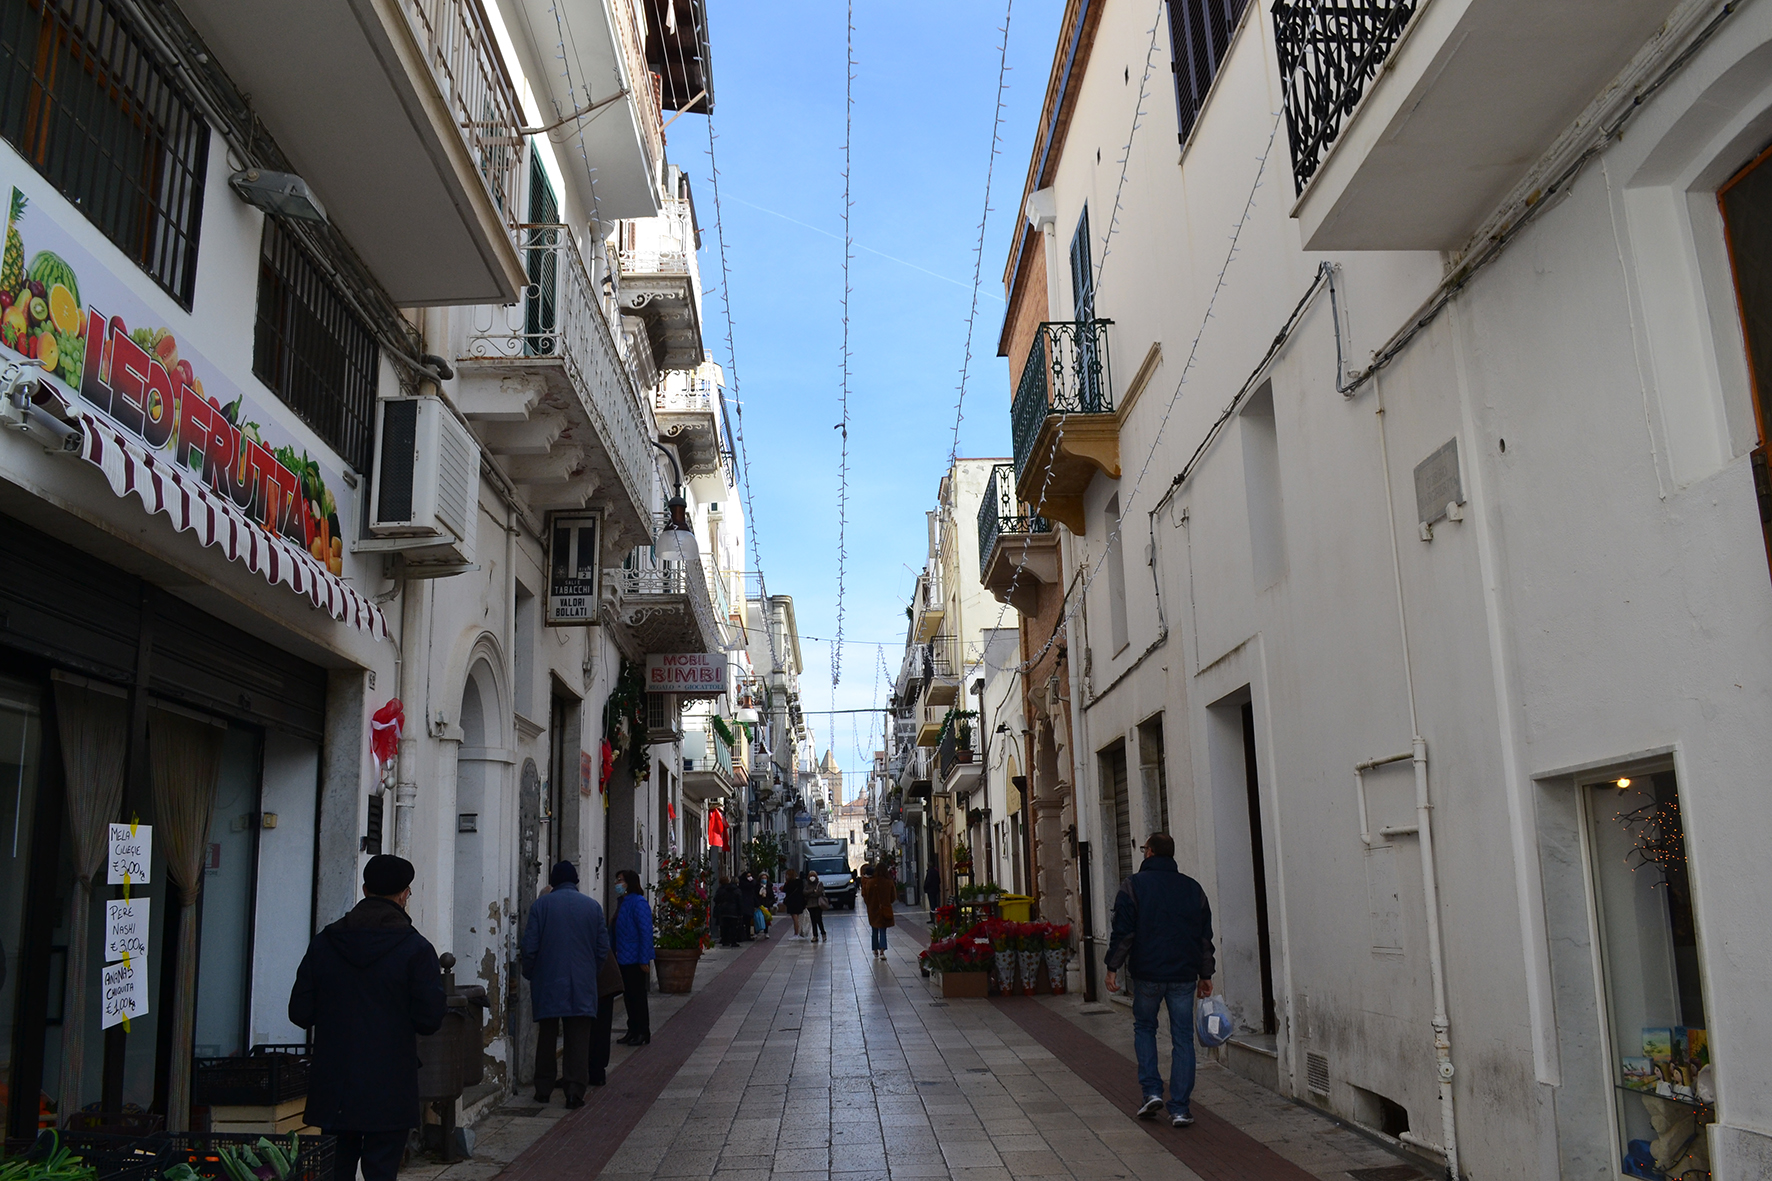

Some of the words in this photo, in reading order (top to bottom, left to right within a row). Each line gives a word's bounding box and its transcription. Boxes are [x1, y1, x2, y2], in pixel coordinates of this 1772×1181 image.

[77, 304, 176, 451] LEO
[174, 383, 309, 554] FRUTTA
[555, 585, 590, 595] TABACCHI
[559, 597, 585, 607] VALORI
[555, 608, 587, 617] BOLLATI
[663, 655, 710, 666] MOBIL
[651, 666, 722, 683] BIMBI
[111, 827, 130, 841] MELA
[109, 905, 134, 920] PERE
[112, 923, 136, 935] NASHI
[104, 966, 134, 985] ANANAS
[106, 982, 134, 999] CHIQUITA
